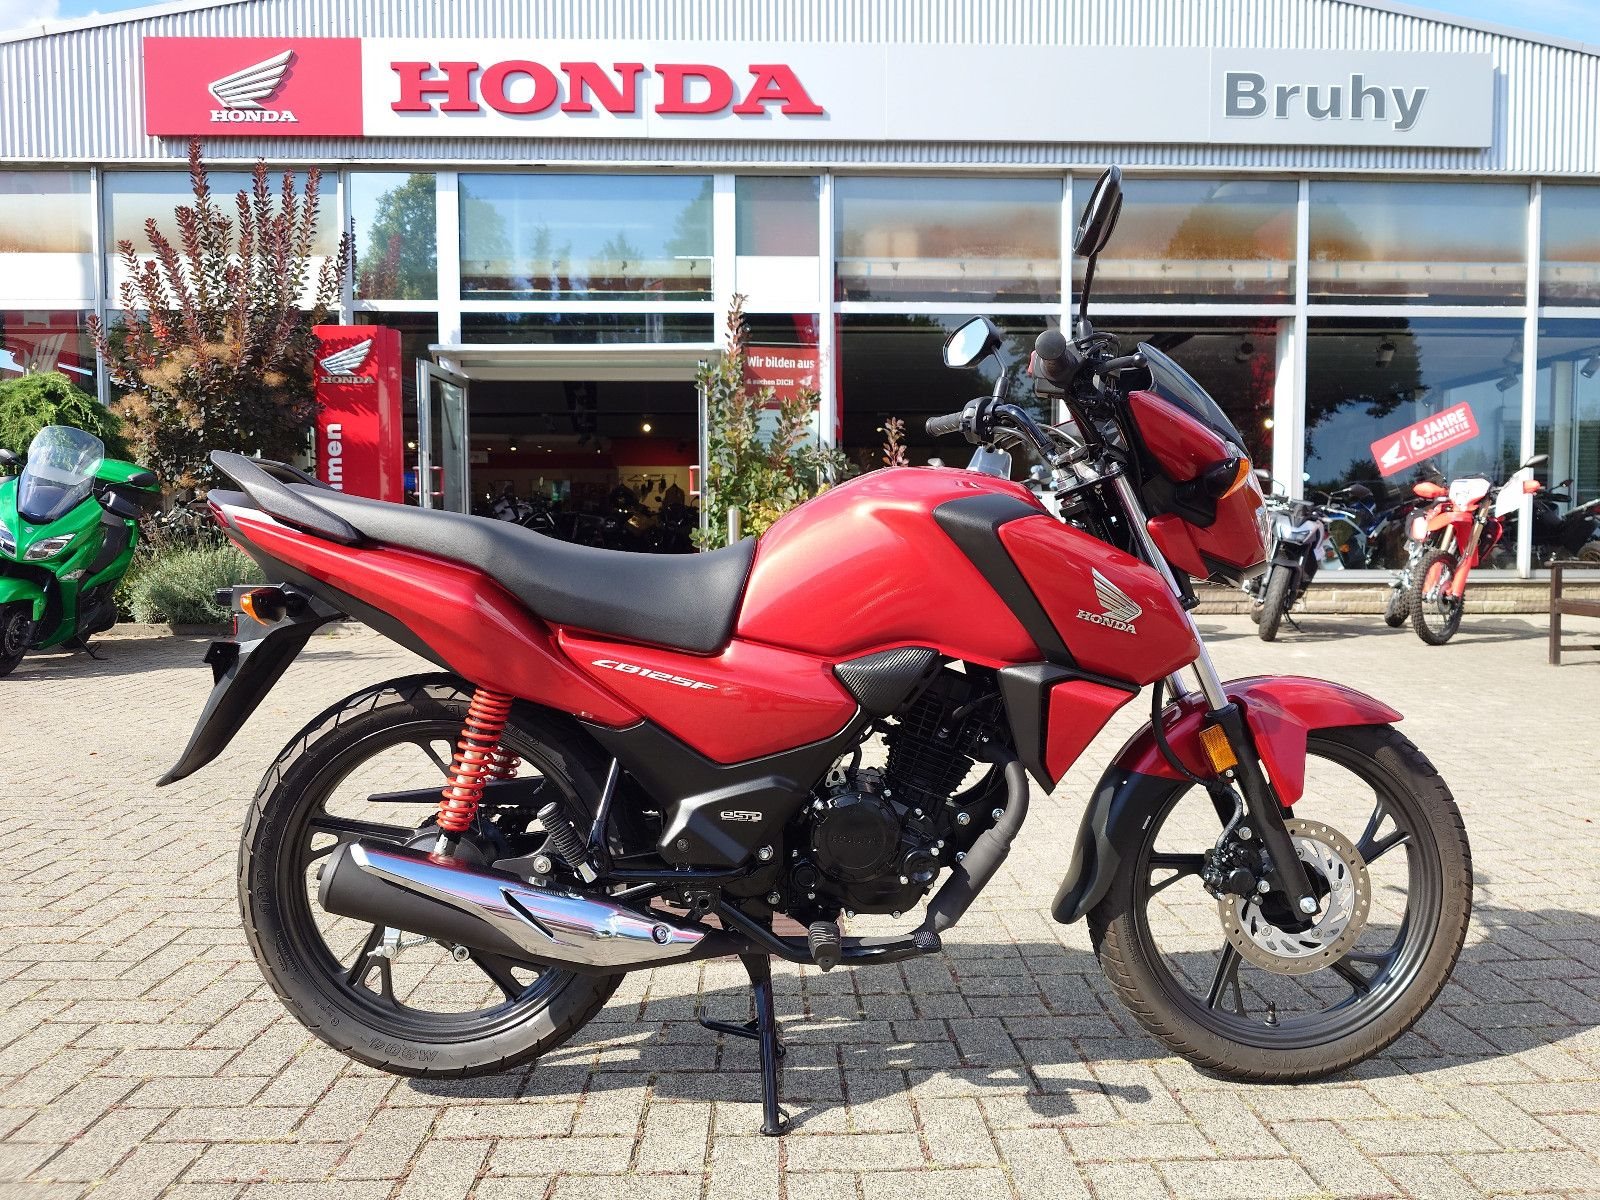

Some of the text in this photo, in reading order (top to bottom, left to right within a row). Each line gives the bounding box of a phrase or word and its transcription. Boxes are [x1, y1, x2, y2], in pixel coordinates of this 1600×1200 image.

[391, 60, 823, 115] HONDA
[1224, 71, 1430, 132] Bruhy
[209, 109, 298, 123] HONDA
[747, 356, 815, 369] Wir bilden aus
[320, 375, 376, 384] HONDA
[1410, 407, 1467, 450] 6 JAHRE
[1426, 420, 1470, 445] GARANTIE
[1076, 609, 1137, 634] HONDA
[591, 659, 719, 690] CB125F
